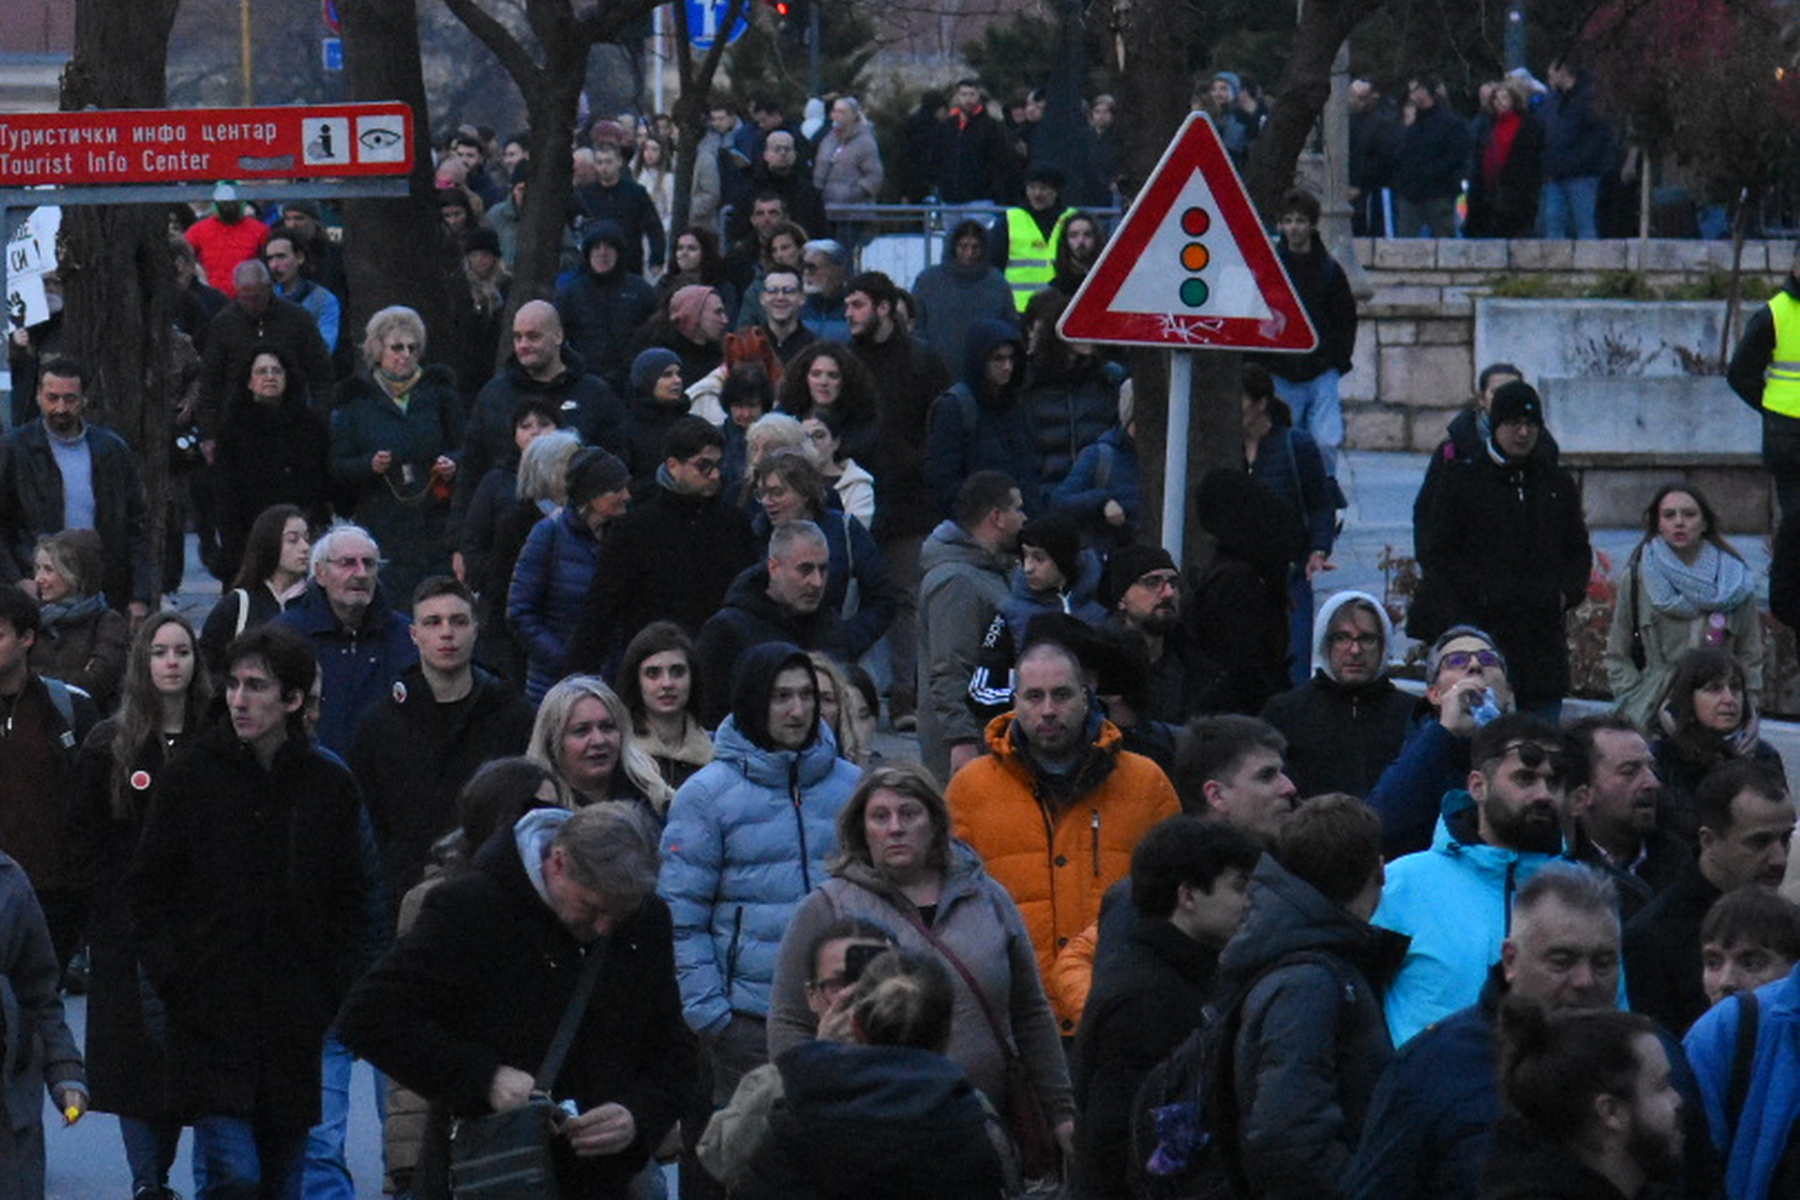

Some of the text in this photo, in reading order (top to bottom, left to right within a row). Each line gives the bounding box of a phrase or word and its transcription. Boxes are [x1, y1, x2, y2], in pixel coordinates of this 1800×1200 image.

[132, 123, 187, 145] инфо
[202, 122, 277, 145] центар
[0, 149, 210, 175] Tourist Info Center
